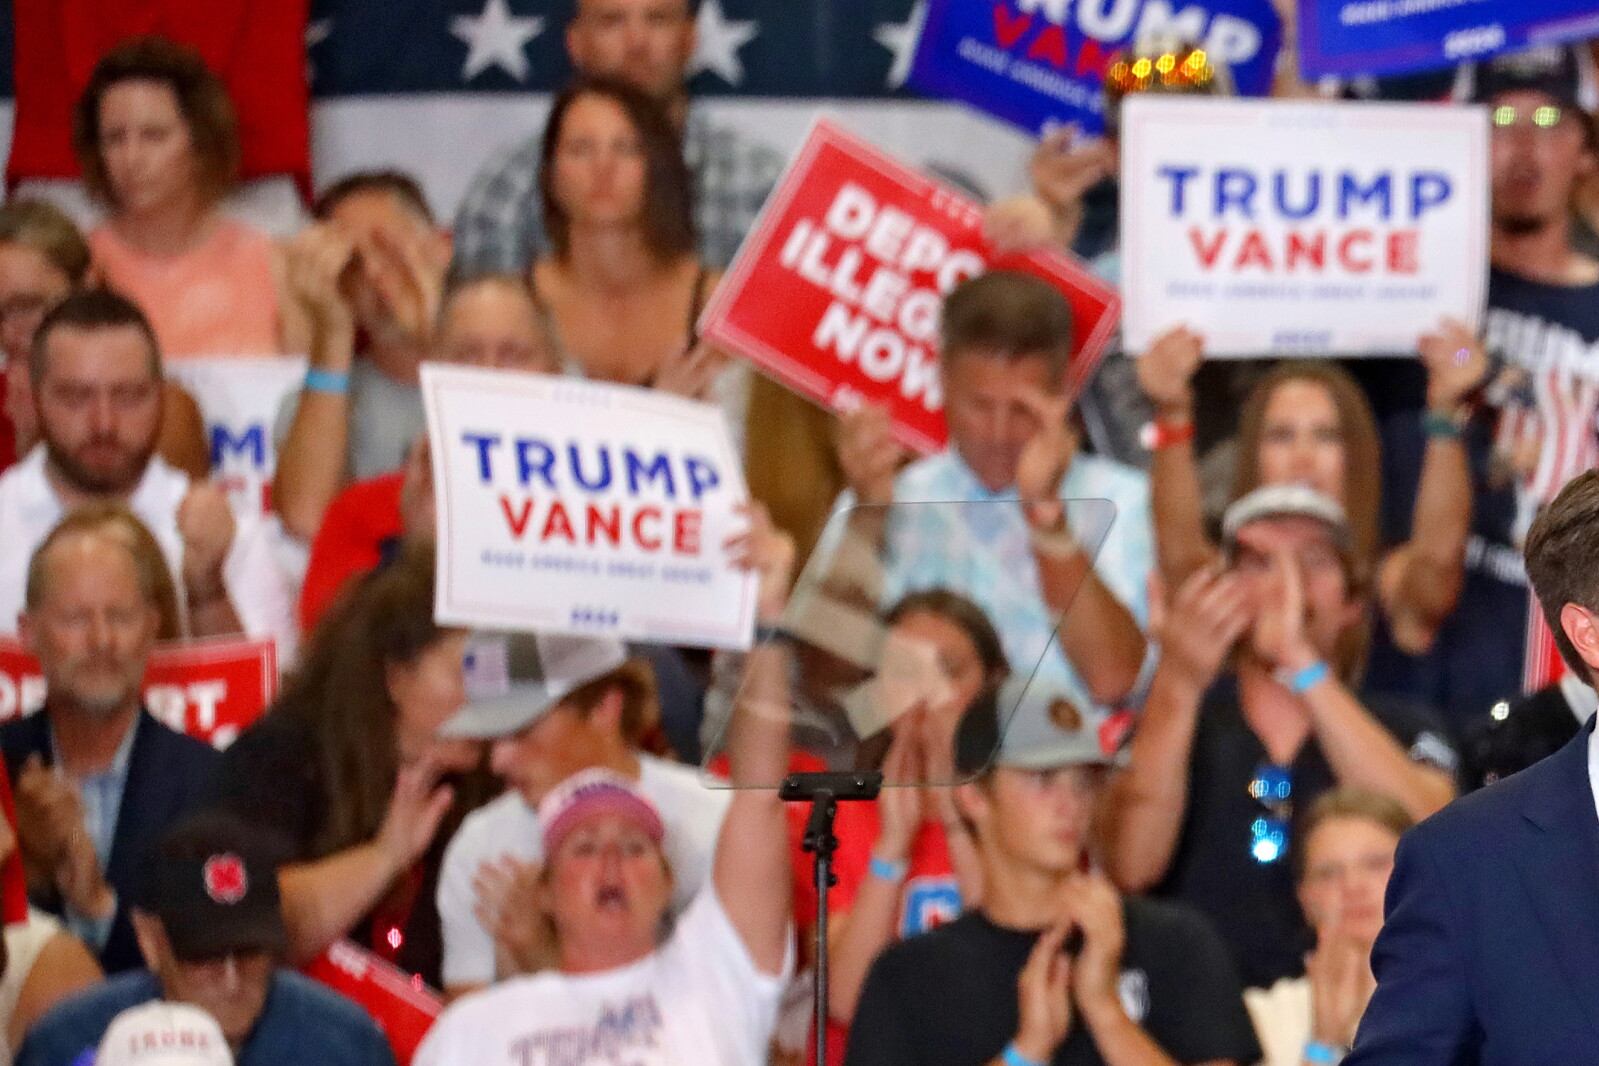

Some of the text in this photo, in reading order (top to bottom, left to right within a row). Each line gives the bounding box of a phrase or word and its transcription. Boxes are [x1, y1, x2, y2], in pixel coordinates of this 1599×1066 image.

[1156, 164, 1454, 219] TRUMP
[1187, 227, 1421, 275] VANCE
[460, 428, 722, 500] TRUMP
[499, 496, 703, 554] VANCE
